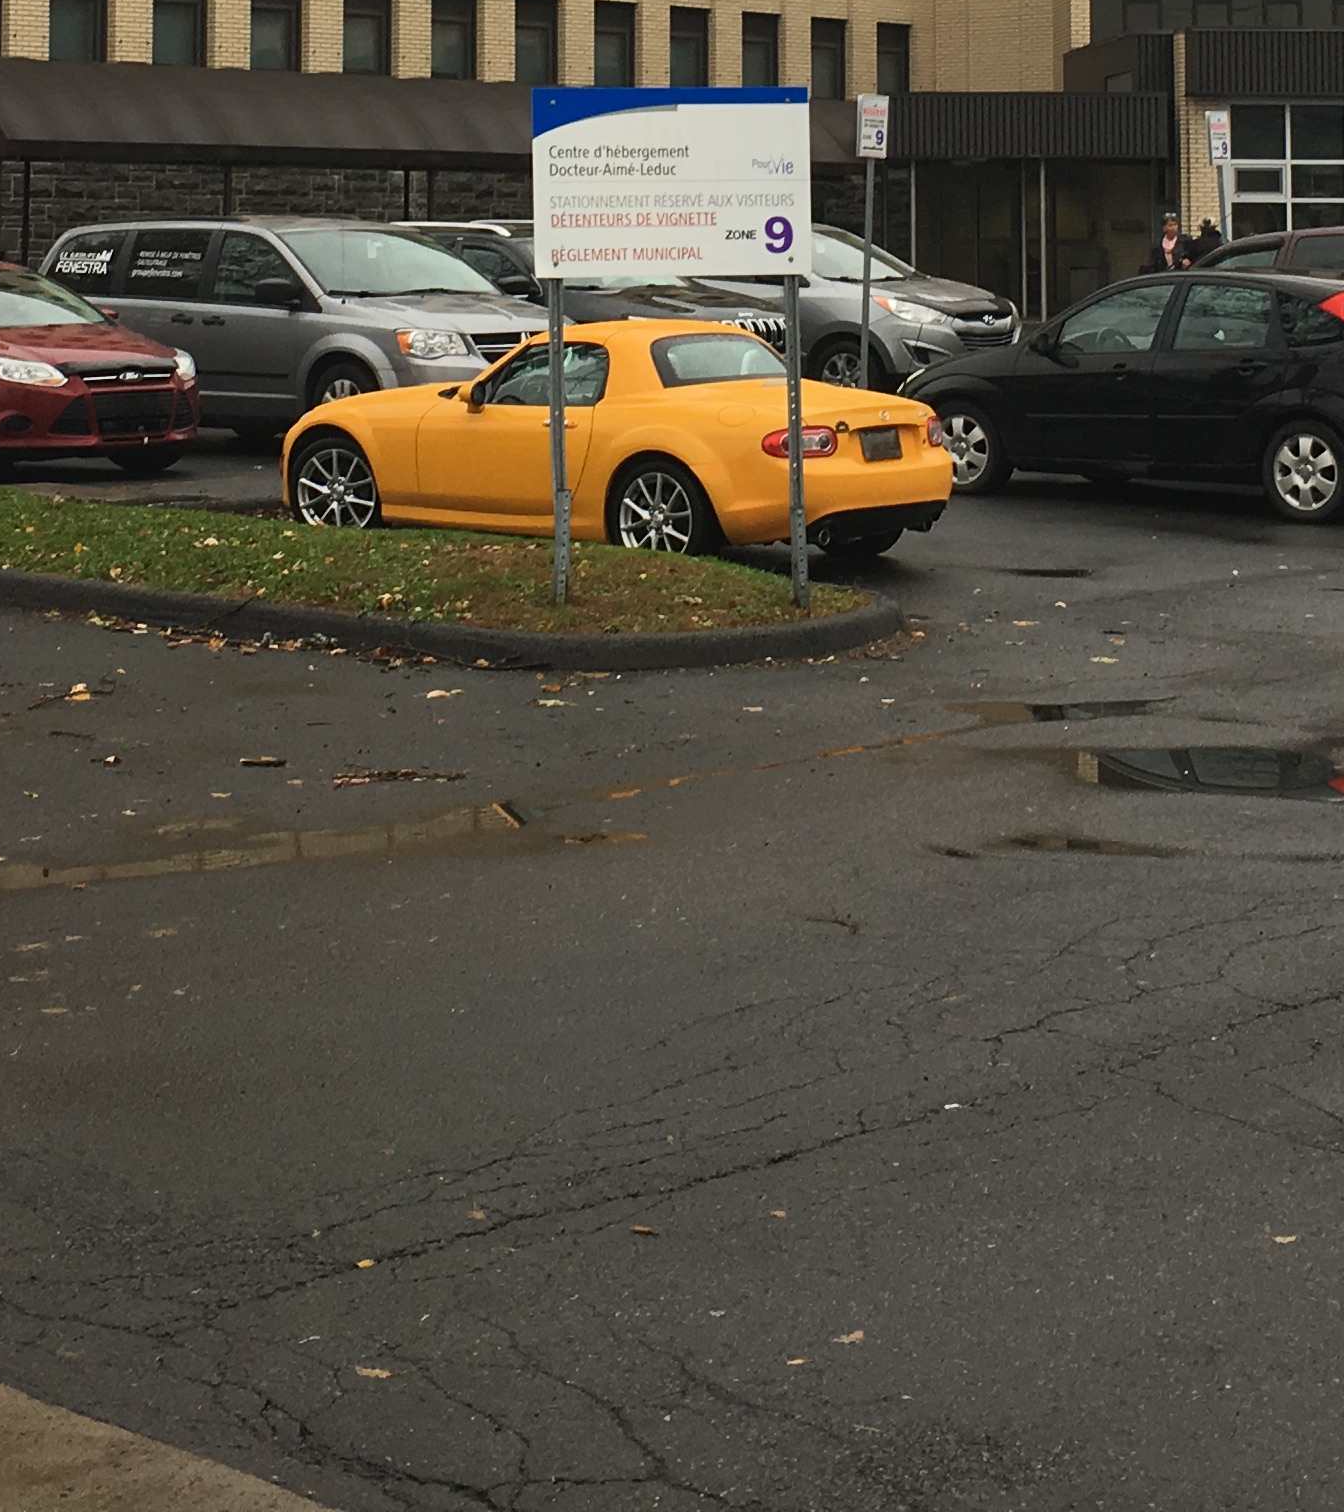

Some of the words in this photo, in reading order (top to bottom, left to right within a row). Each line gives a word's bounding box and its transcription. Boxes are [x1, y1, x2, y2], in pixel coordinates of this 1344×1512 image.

[875, 130, 884, 145] 9
[549, 145, 590, 159] Centre
[594, 144, 689, 161] d'hébergement
[549, 163, 677, 177] Docteur-Aimé-Leduc
[550, 194, 651, 209] STATIONNEMENT
[654, 191, 703, 208] RÉSERVÉ
[708, 194, 733, 207] AUX
[736, 193, 795, 207] VISITEURS
[551, 211, 632, 227] DÉTENTEURS
[636, 212, 652, 226] DE
[656, 211, 717, 226] VIGNETTE
[725, 229, 757, 240] ZONE
[764, 216, 793, 254] 9
[551, 245, 628, 262] RÈGLEMENT
[633, 247, 703, 261] MUNICIPAL
[55, 260, 107, 274] FENESTRA
